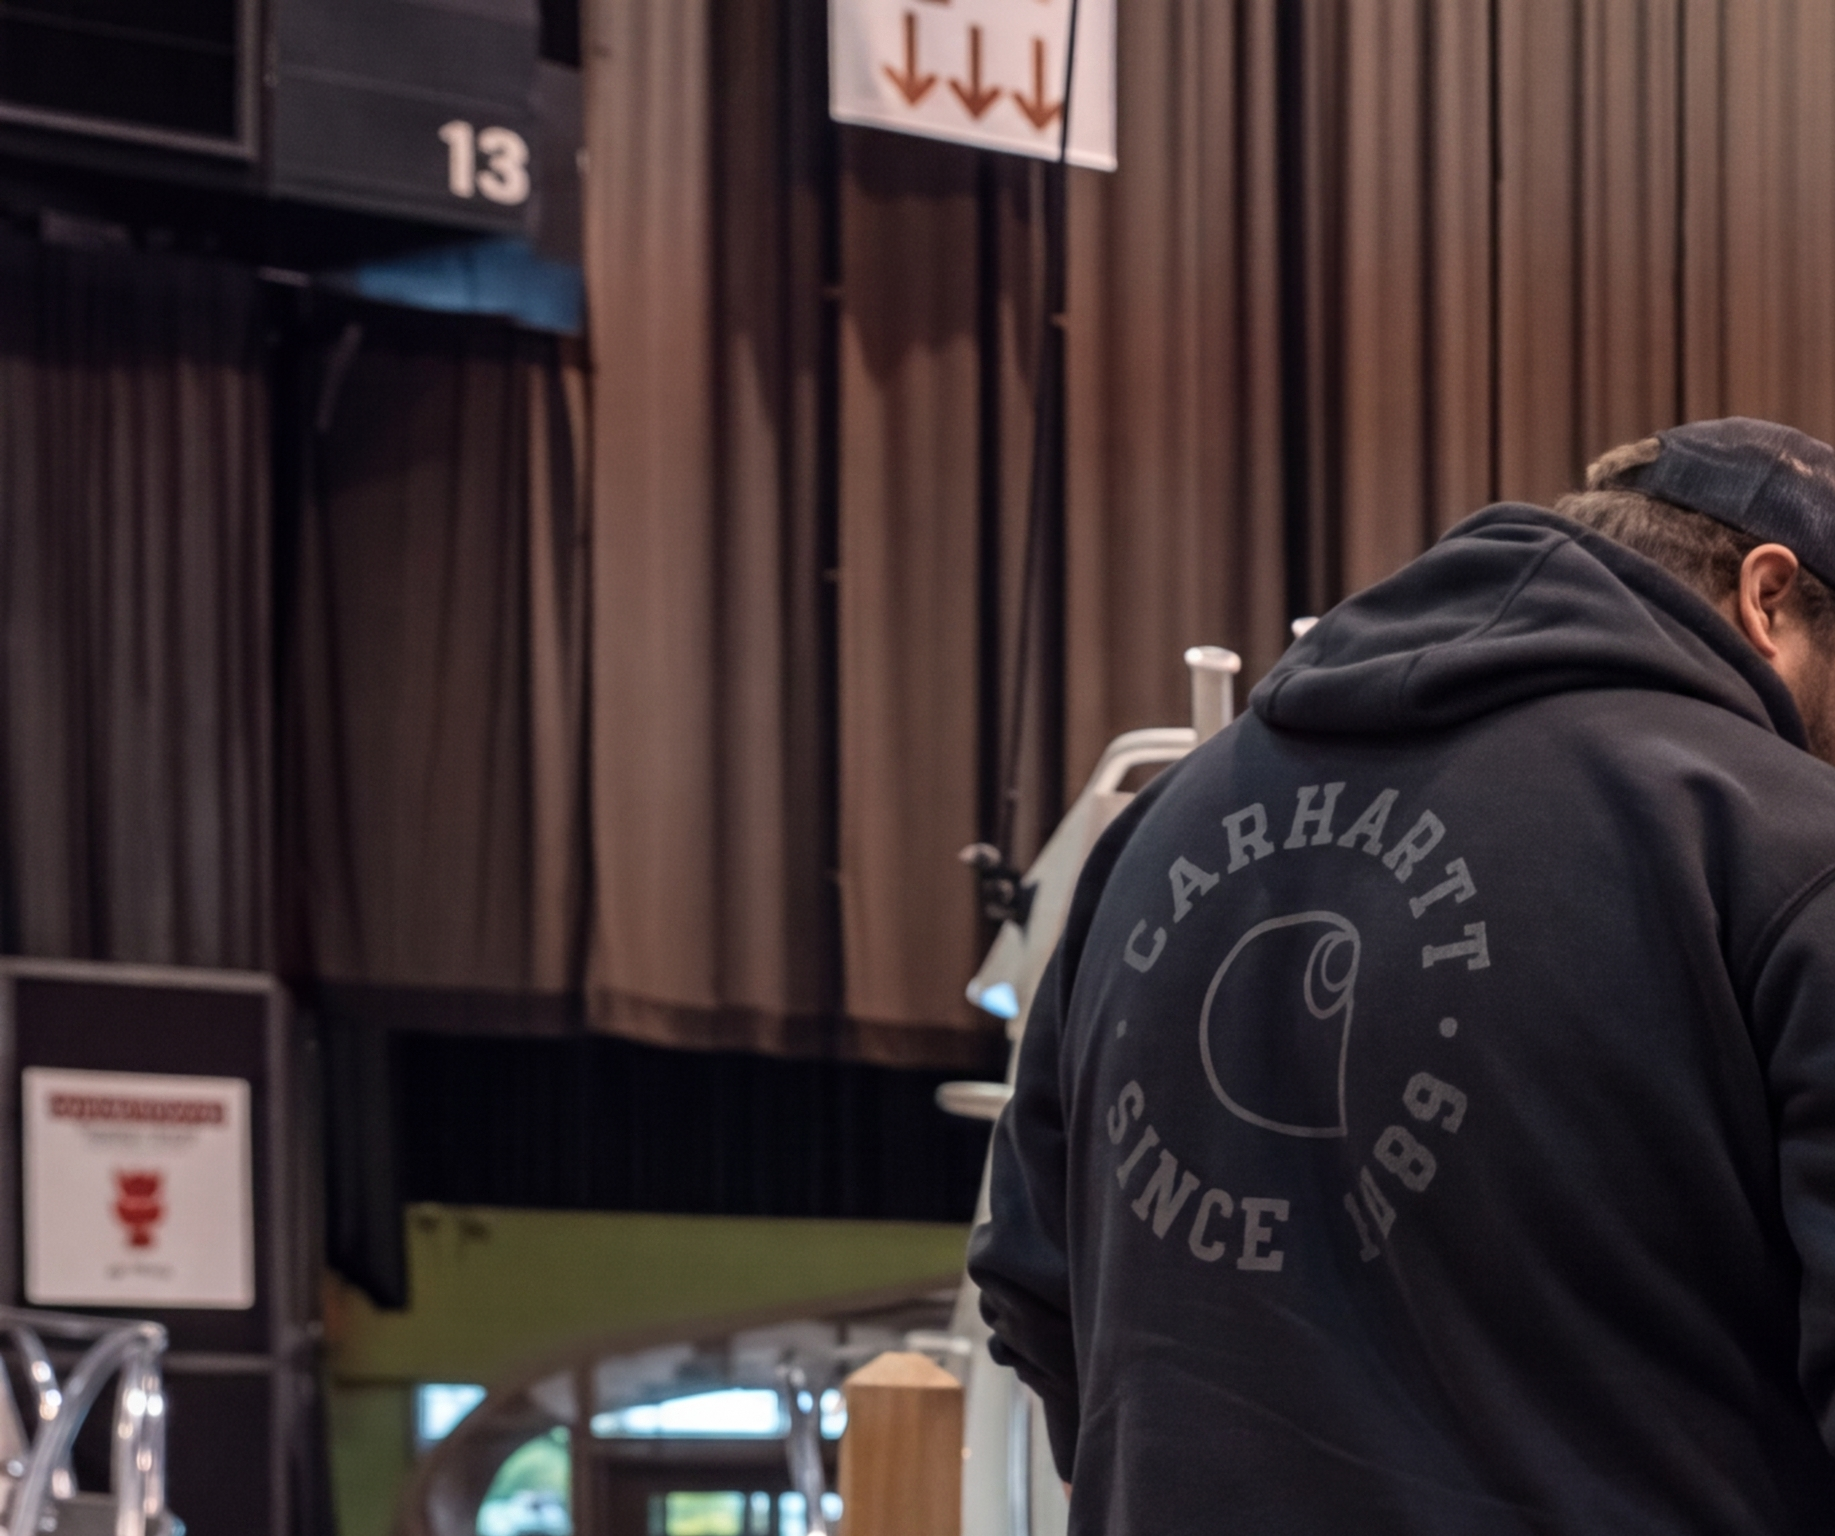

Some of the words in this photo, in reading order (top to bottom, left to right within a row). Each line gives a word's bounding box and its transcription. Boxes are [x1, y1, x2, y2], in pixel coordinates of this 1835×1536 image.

[438, 119, 530, 206] 13
[1123, 781, 1491, 974] CARHARTT
[1107, 1080, 1290, 1272] SINCE
